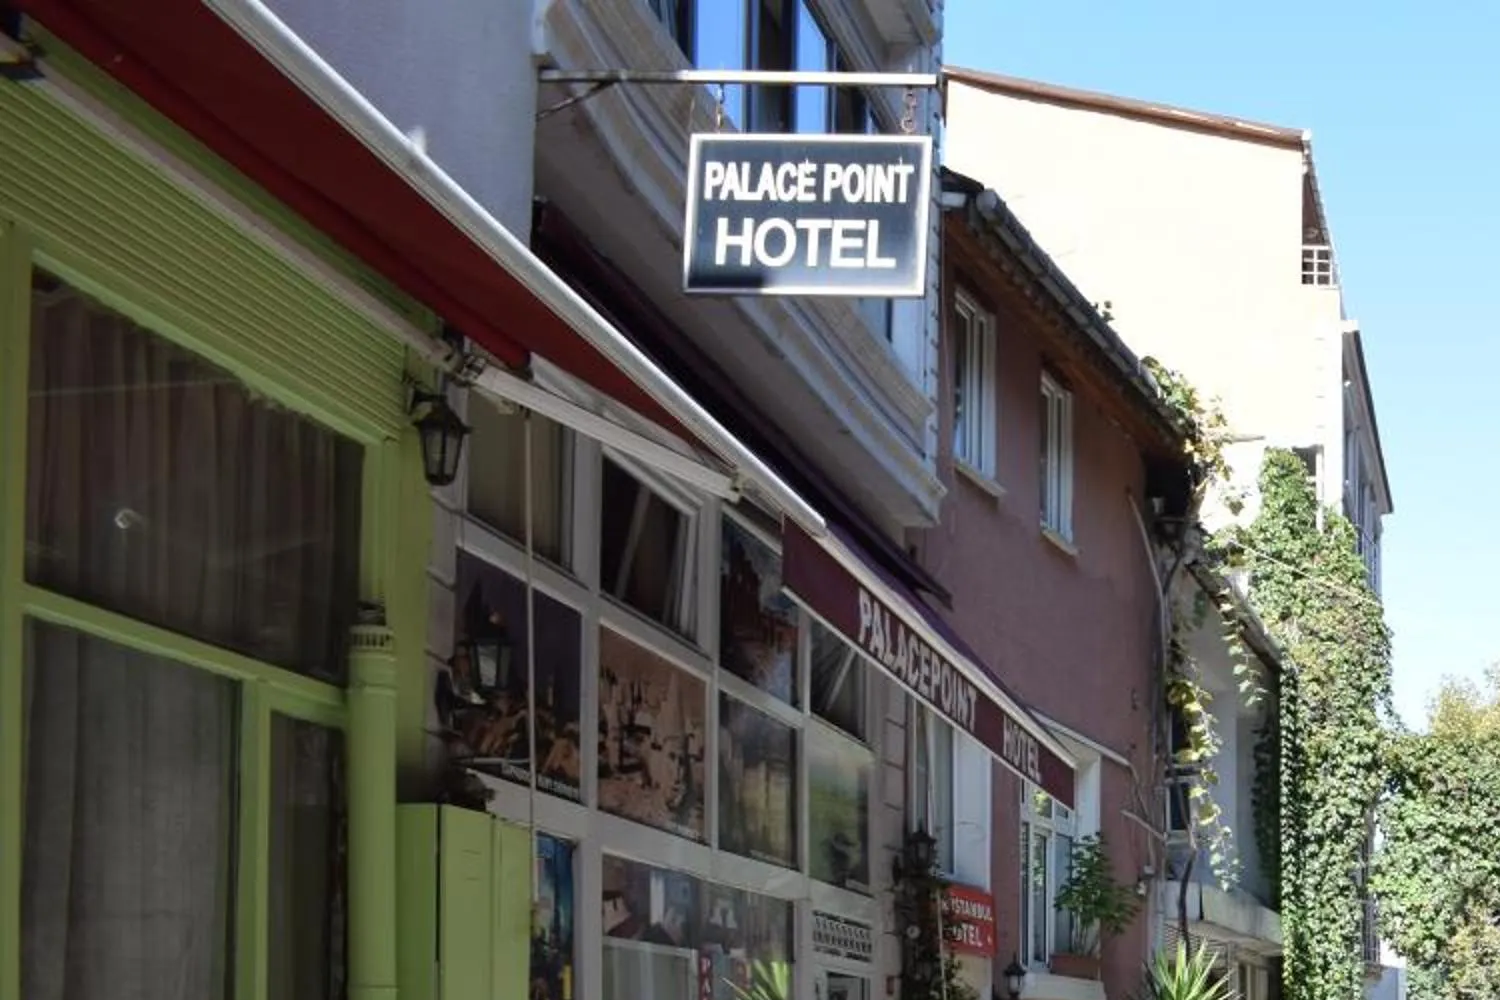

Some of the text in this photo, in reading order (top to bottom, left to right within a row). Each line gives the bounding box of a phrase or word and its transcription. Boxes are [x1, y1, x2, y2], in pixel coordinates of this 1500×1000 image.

[704, 161, 915, 203] PALACE POINT
[715, 217, 897, 269] HOTEL
[1003, 713, 1042, 785] HOTEL
